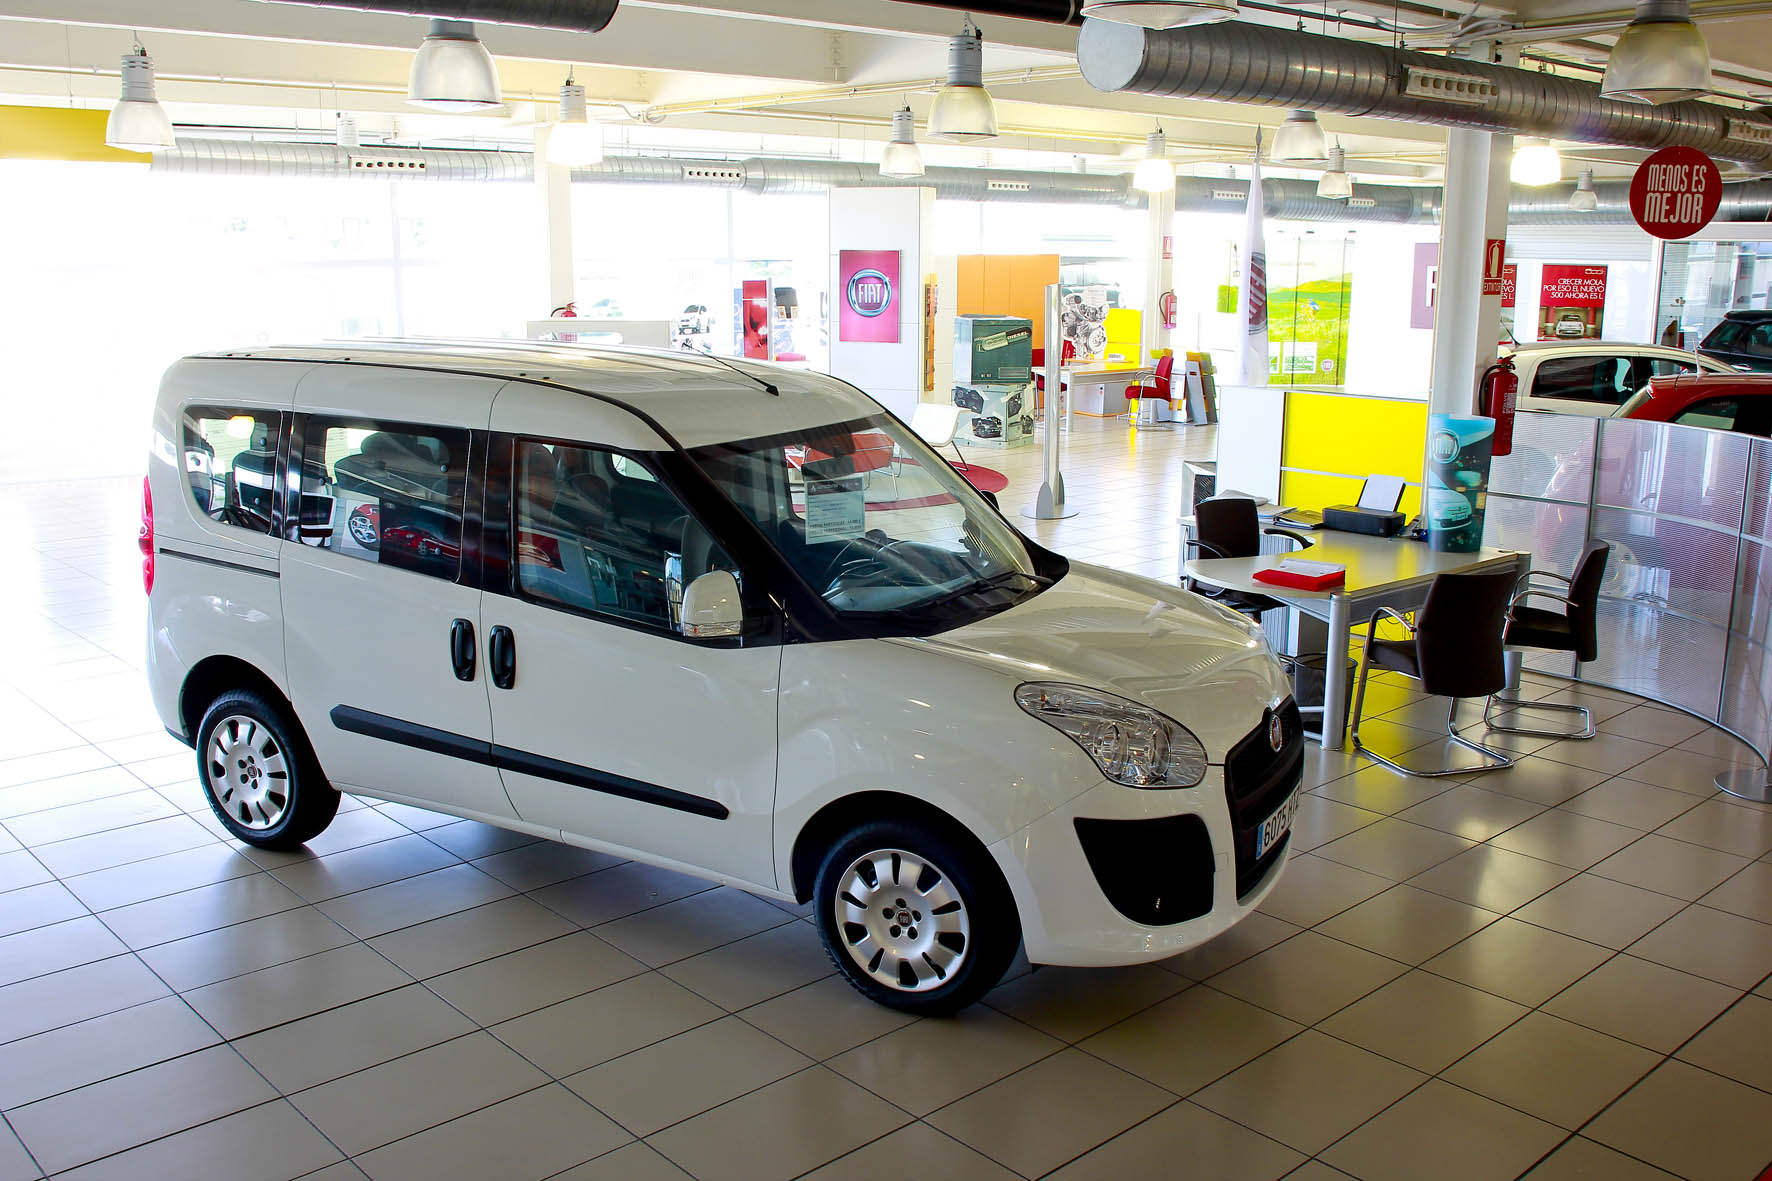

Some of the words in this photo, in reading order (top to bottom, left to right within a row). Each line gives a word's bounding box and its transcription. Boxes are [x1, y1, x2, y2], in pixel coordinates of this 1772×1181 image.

[1647, 164, 1689, 192] MENOS
[1691, 164, 1707, 192] ES
[1644, 192, 1704, 224] MEJOR
[858, 283, 882, 304] FIAT
[1558, 278, 1583, 286] CRECER
[1263, 804, 1287, 847] 6075
